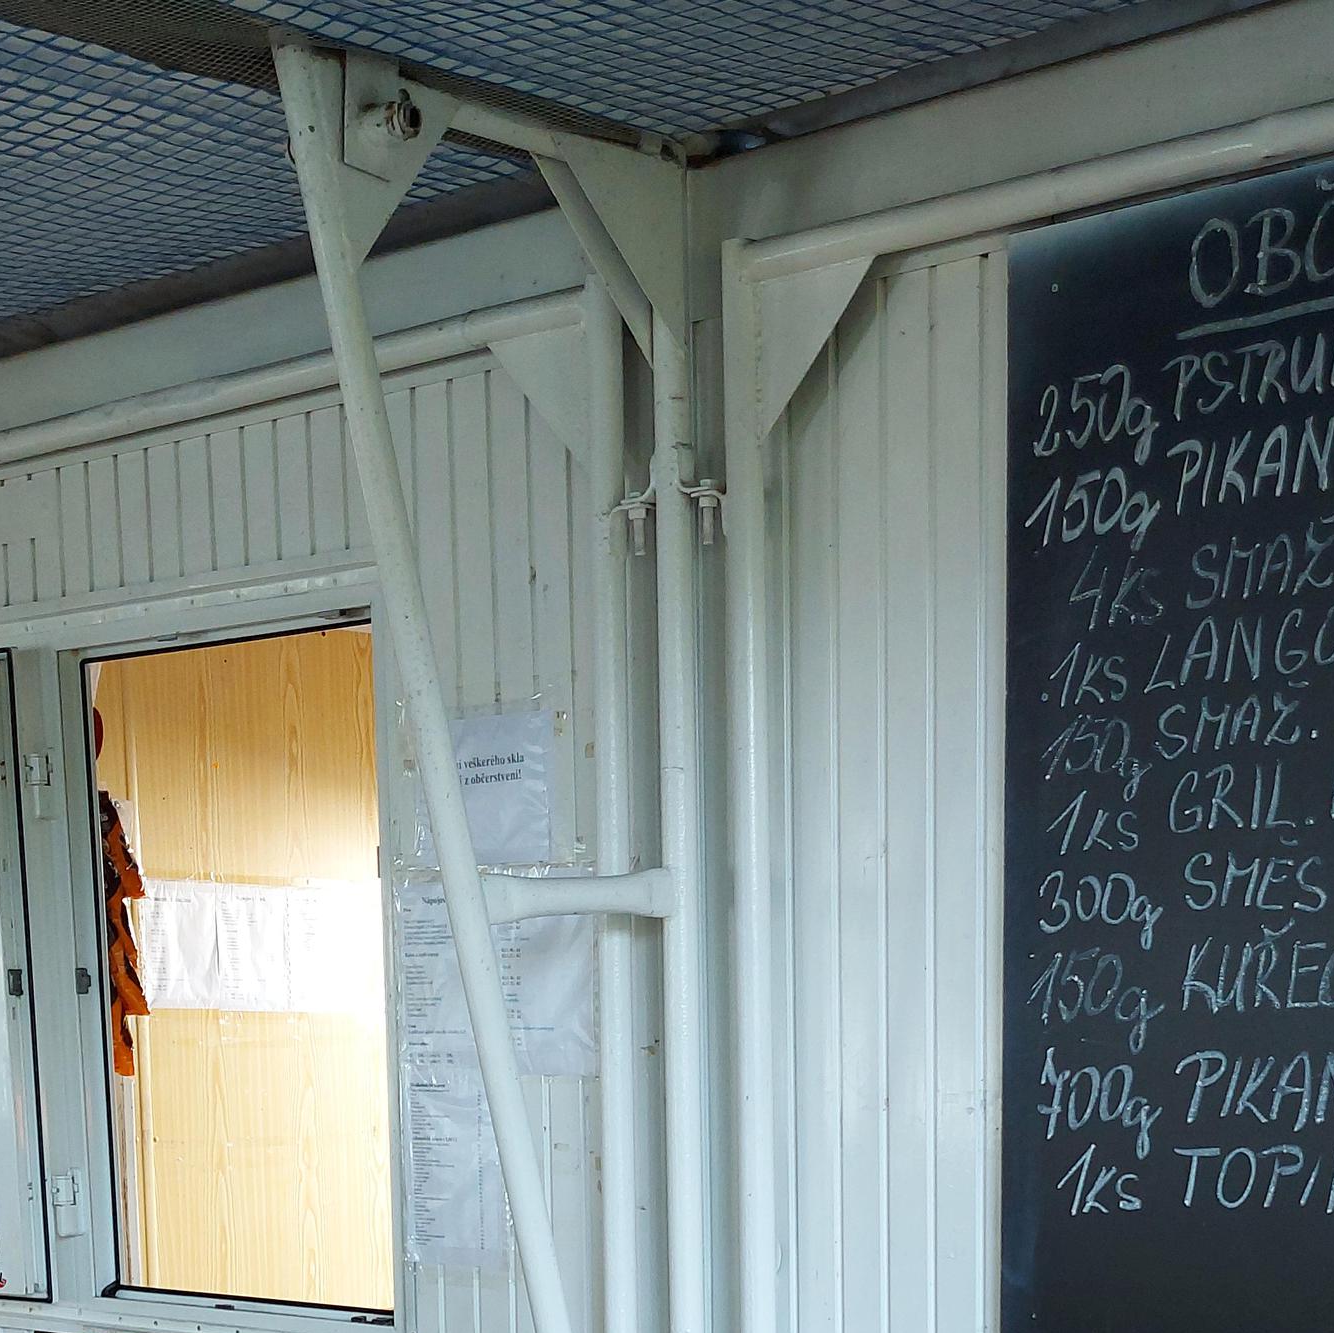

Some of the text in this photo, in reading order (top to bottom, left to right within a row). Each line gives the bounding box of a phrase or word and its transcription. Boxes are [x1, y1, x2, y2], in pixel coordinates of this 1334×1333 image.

[1033, 364, 1159, 464] 250g
[1025, 467, 1160, 551] 150g
[507, 752, 525, 764] skla
[1040, 714, 1152, 801] 150g
[1039, 870, 1164, 949] 300g
[1184, 836, 1328, 912] SMĚS
[1026, 947, 1165, 1053] 150g
[1038, 1047, 1163, 1160] 700g
